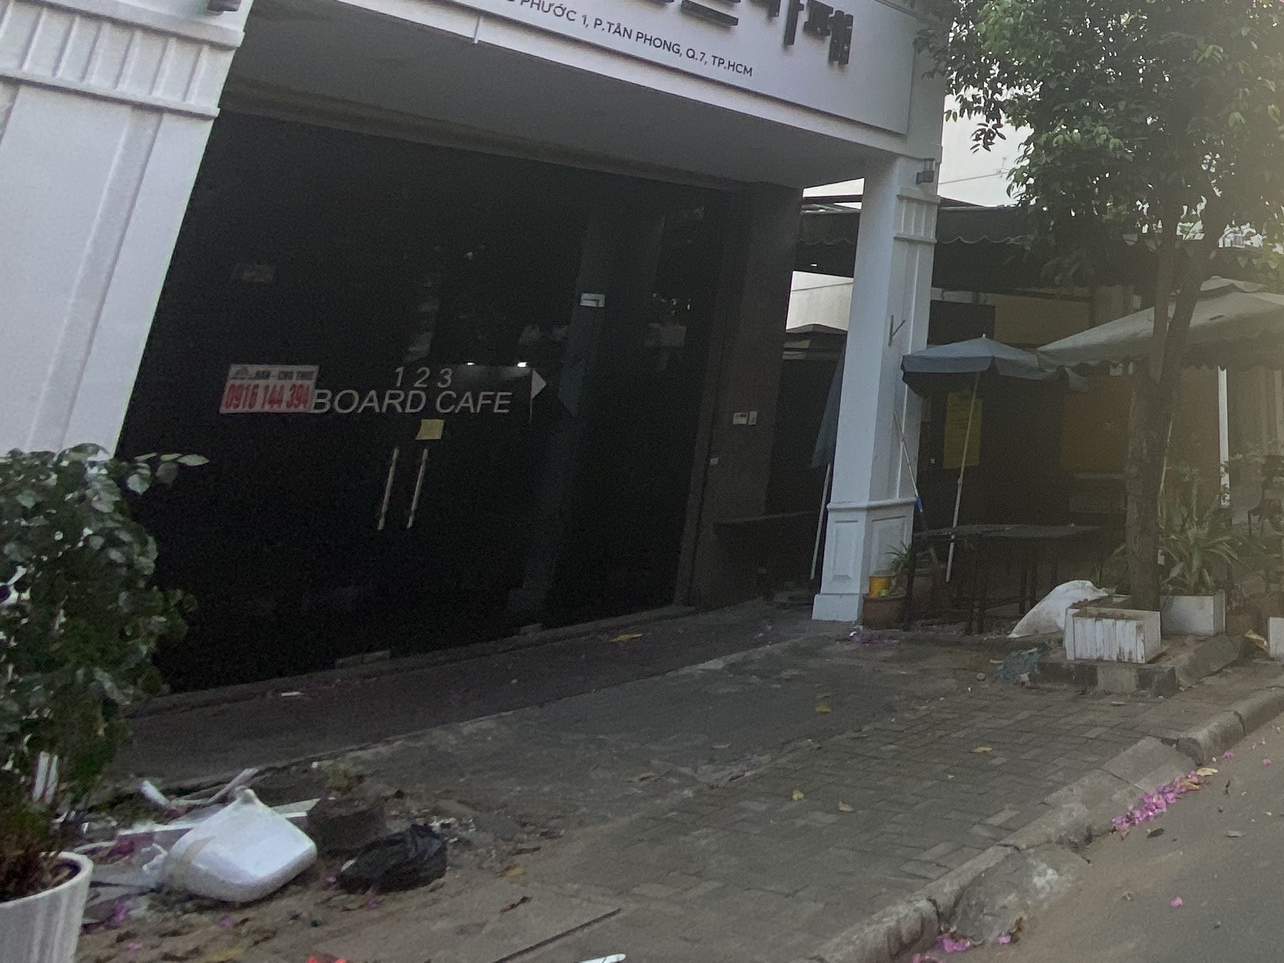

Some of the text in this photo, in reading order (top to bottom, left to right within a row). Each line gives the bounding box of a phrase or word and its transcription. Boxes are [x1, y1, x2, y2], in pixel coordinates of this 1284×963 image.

[581, 15, 589, 29] 1,
[593, 18, 633, 40] P.TÂN
[635, 31, 683, 57] PHONG,
[686, 48, 708, 66] Q.7,
[711, 55, 753, 77] TP.HCM
[261, 384, 285, 409] 144
[312, 389, 512, 413] BOARD CAFE
